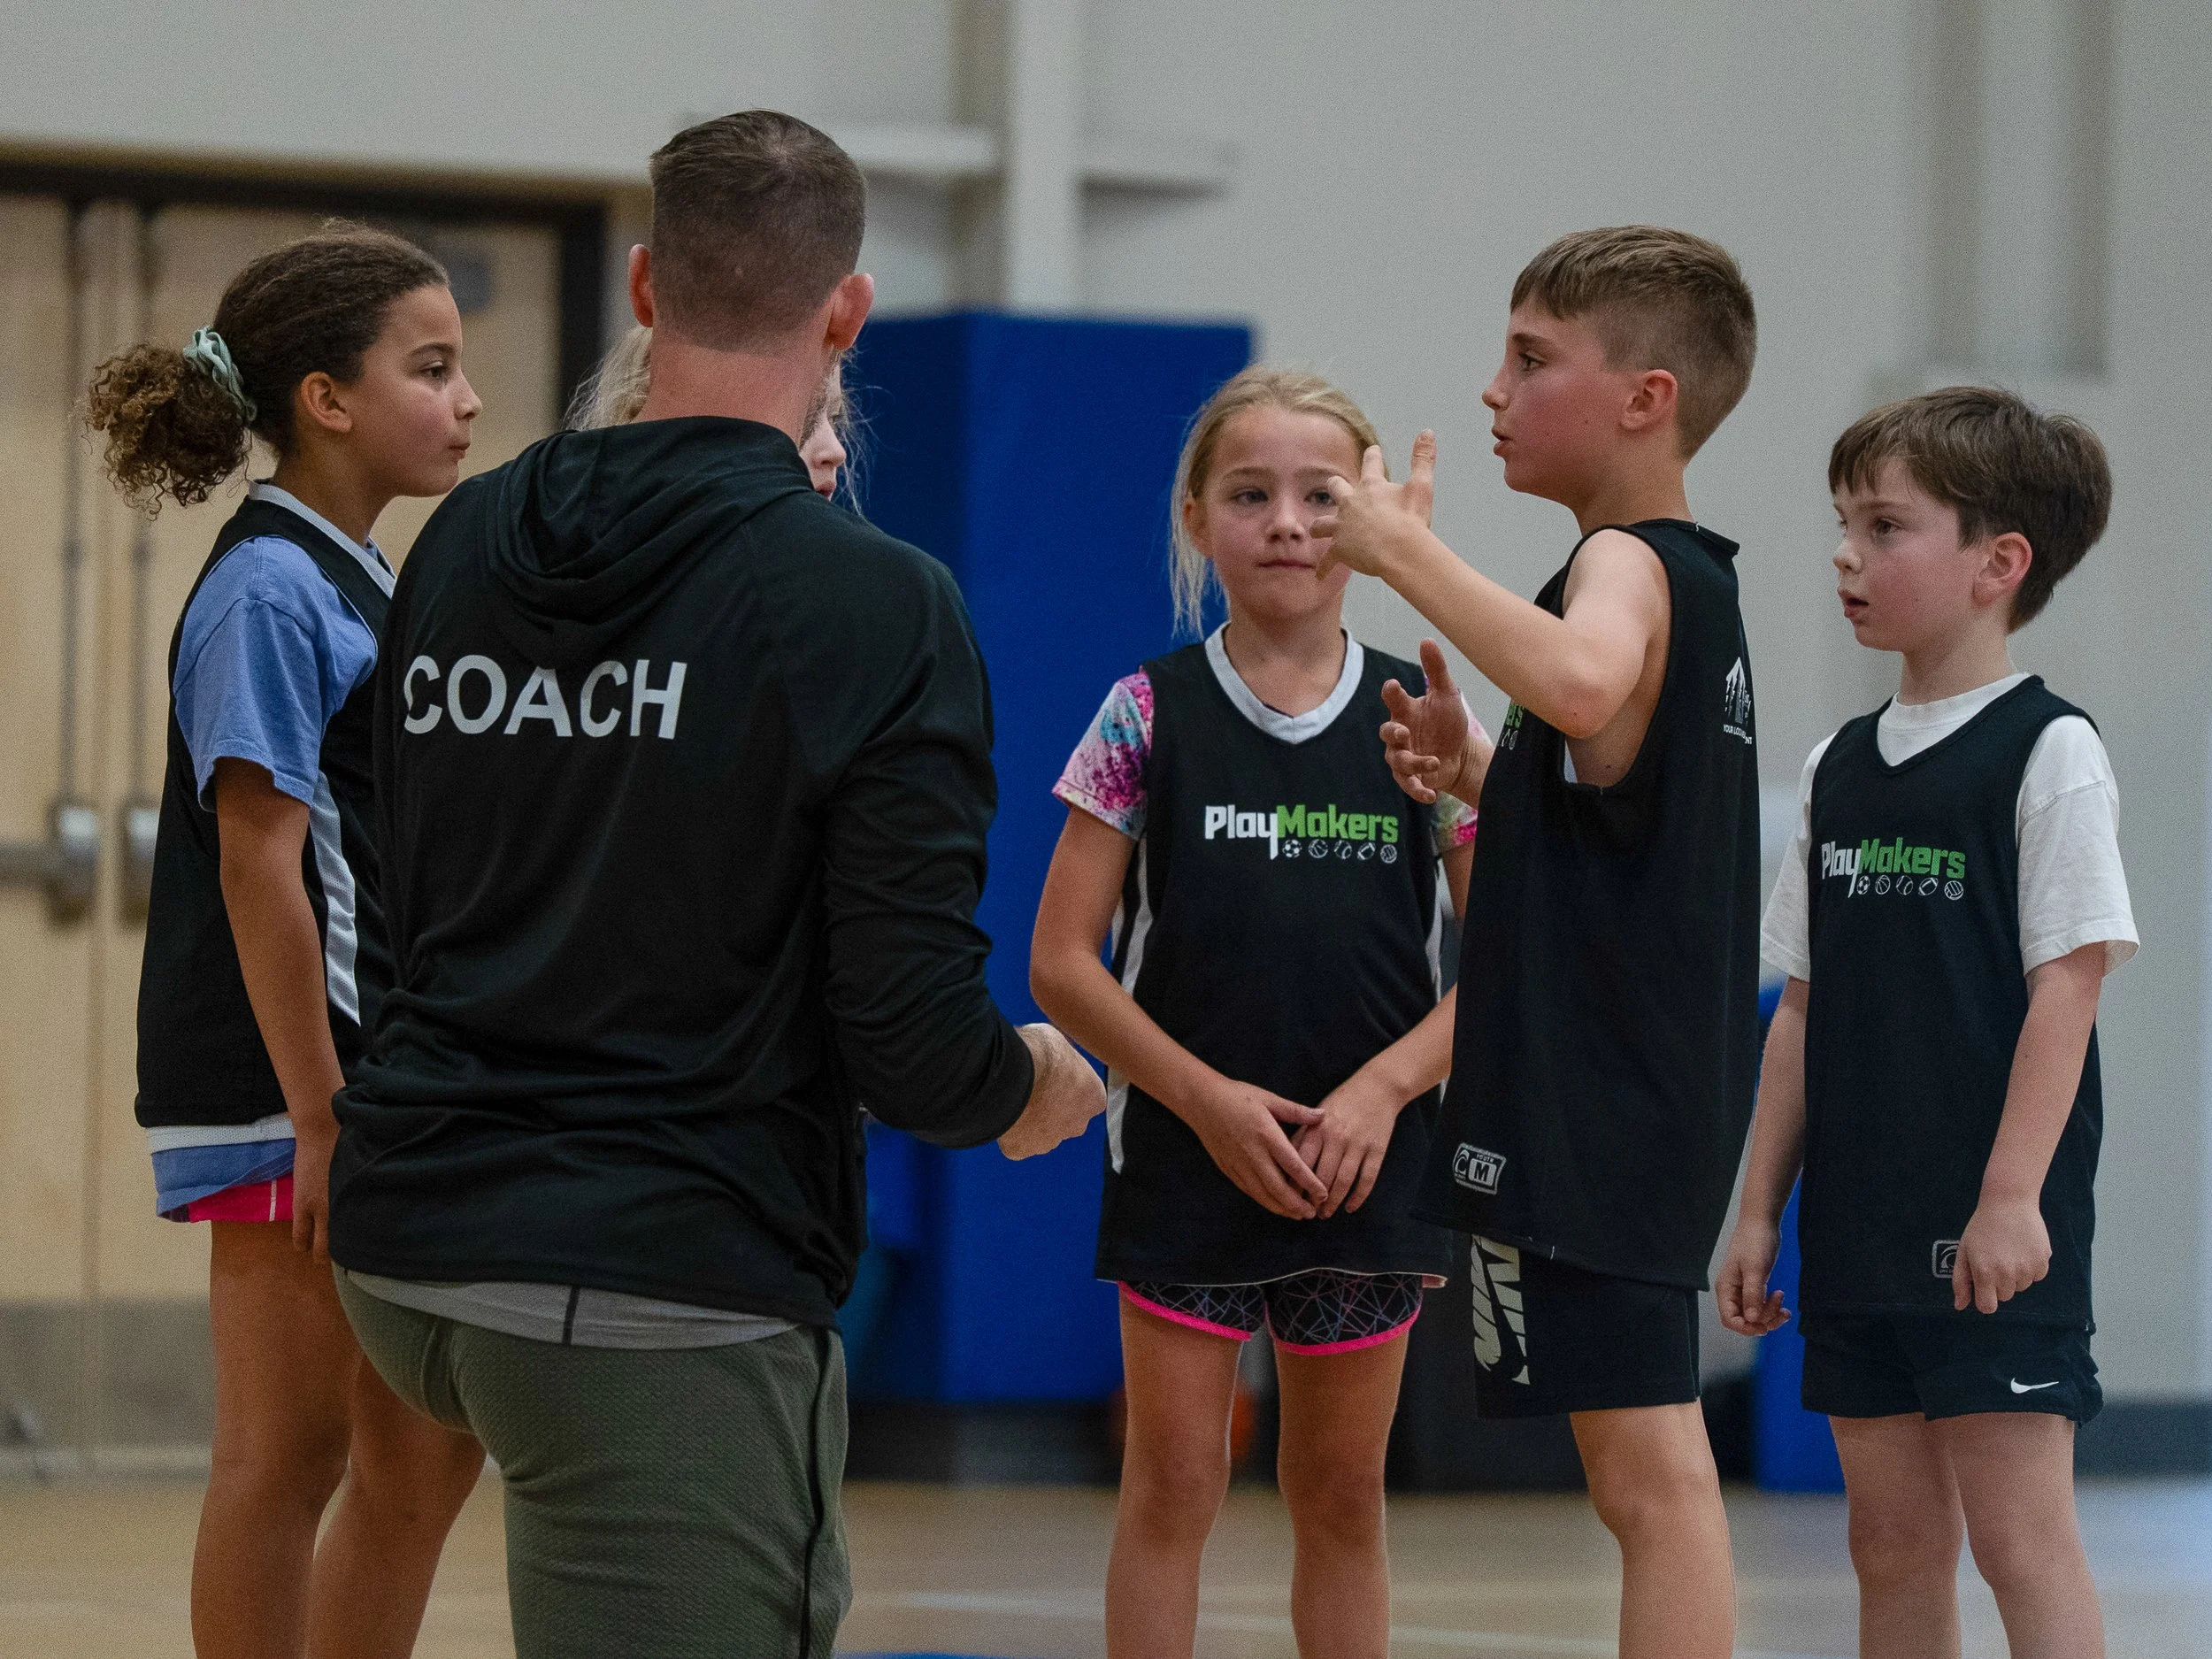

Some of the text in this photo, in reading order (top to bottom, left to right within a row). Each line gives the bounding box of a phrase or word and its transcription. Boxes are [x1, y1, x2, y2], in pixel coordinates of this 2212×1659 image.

[403, 655, 687, 740] COACH
[1204, 803, 1399, 860] PlayMakers
[1821, 837, 1966, 898] PlayMakers
[1474, 1162, 1490, 1182] M
